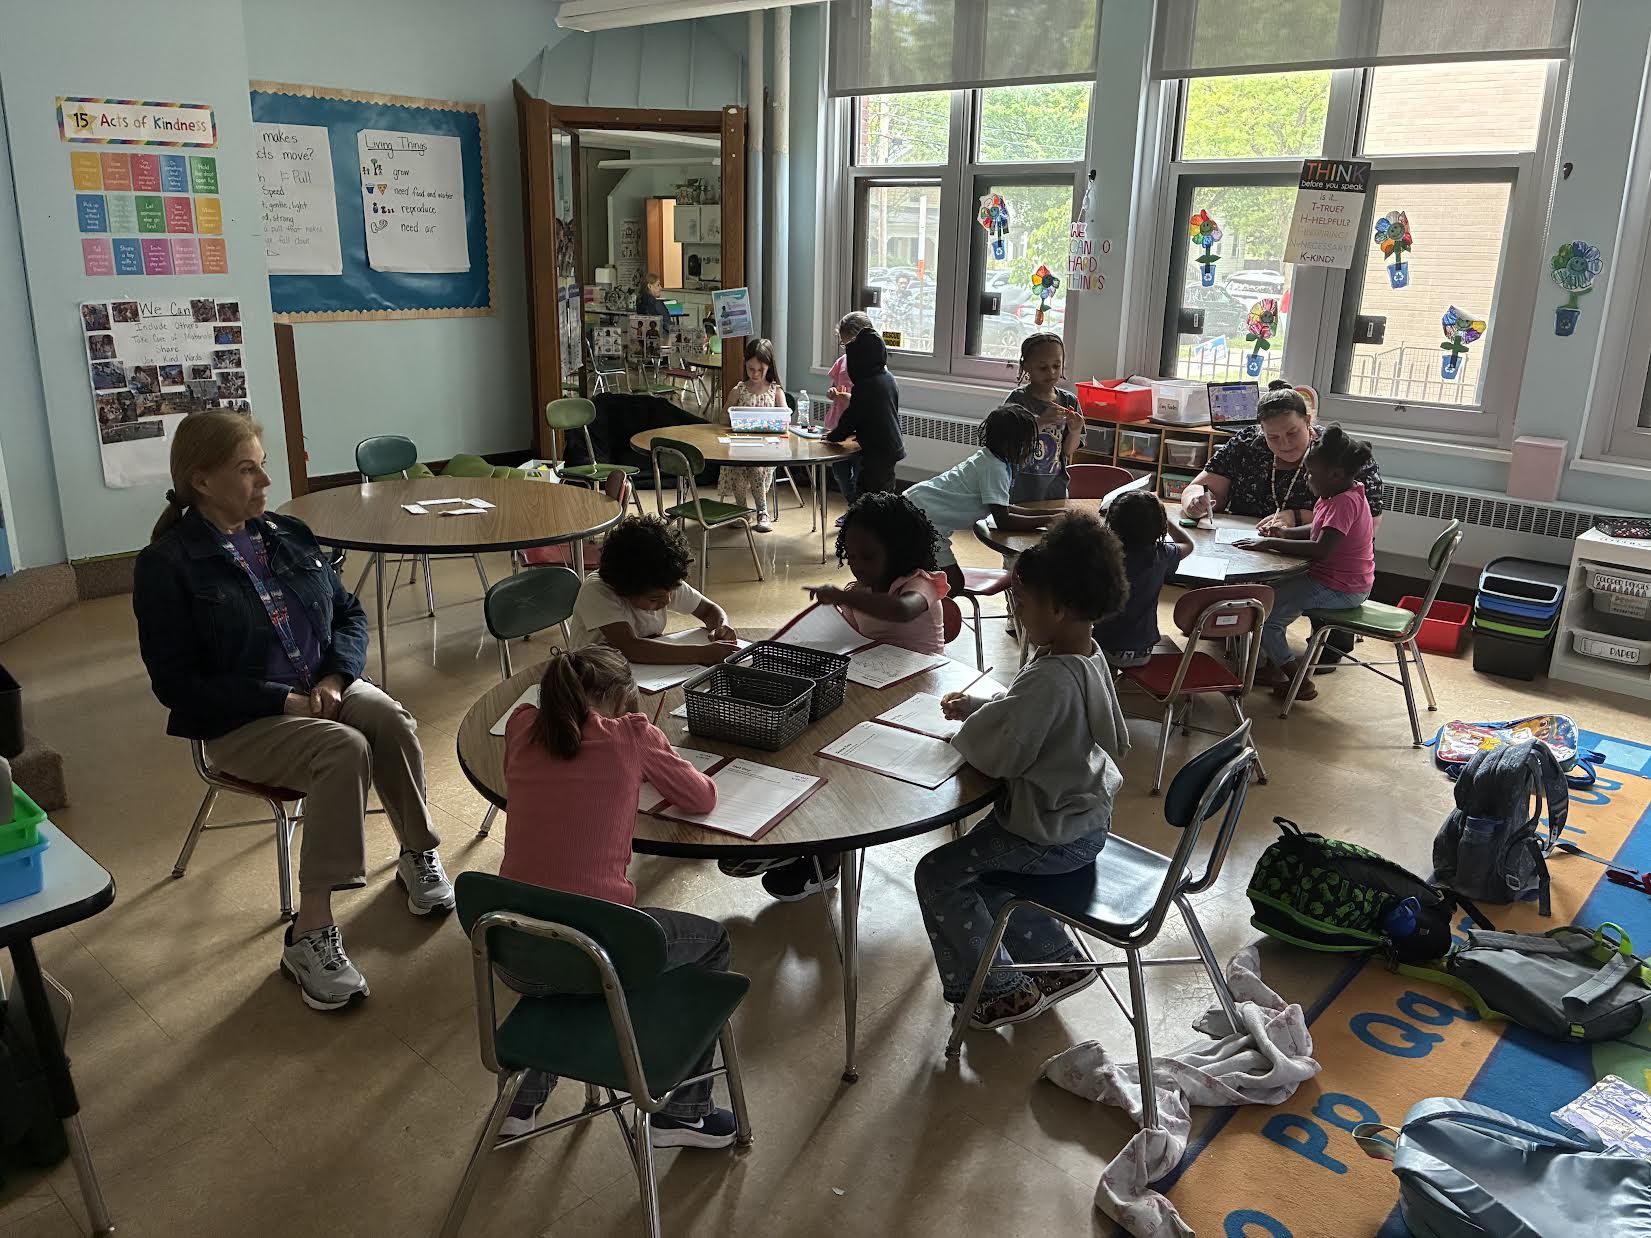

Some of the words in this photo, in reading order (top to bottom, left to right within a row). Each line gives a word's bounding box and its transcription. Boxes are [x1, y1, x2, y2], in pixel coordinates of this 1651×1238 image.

[73, 112, 89, 128] 15
[100, 113, 128, 128] Acts
[133, 115, 148, 128] of
[153, 115, 207, 132] Kindness
[263, 131, 298, 143] makes
[365, 134, 394, 159] Living
[398, 136, 428, 157] Things
[282, 147, 315, 161] move?
[292, 169, 312, 184] Pull
[392, 169, 410, 180] grow
[1306, 162, 1367, 182] THINK
[262, 185, 285, 198] Speed
[393, 187, 409, 196] need
[412, 186, 425, 197] food
[1325, 182, 1339, 190] you
[1340, 183, 1364, 191] speak
[401, 202, 437, 216] reproduce
[1311, 202, 1344, 214] T-TRUE?
[1300, 213, 1351, 227] H-HELPFUL?
[401, 221, 419, 233] need
[1070, 222, 1087, 238] WE
[1069, 239, 1092, 255] CAN
[1299, 251, 1336, 263] K-KIND?
[1067, 255, 1098, 273] HARD
[138, 301, 162, 316] We
[170, 301, 191, 316] Can
[134, 322, 168, 332] Include
[175, 321, 199, 331] Others
[130, 335, 149, 344] Take
[155, 344, 179, 353] Share
[163, 354, 179, 364] Kind
[1609, 647, 1638, 660] PAPER
